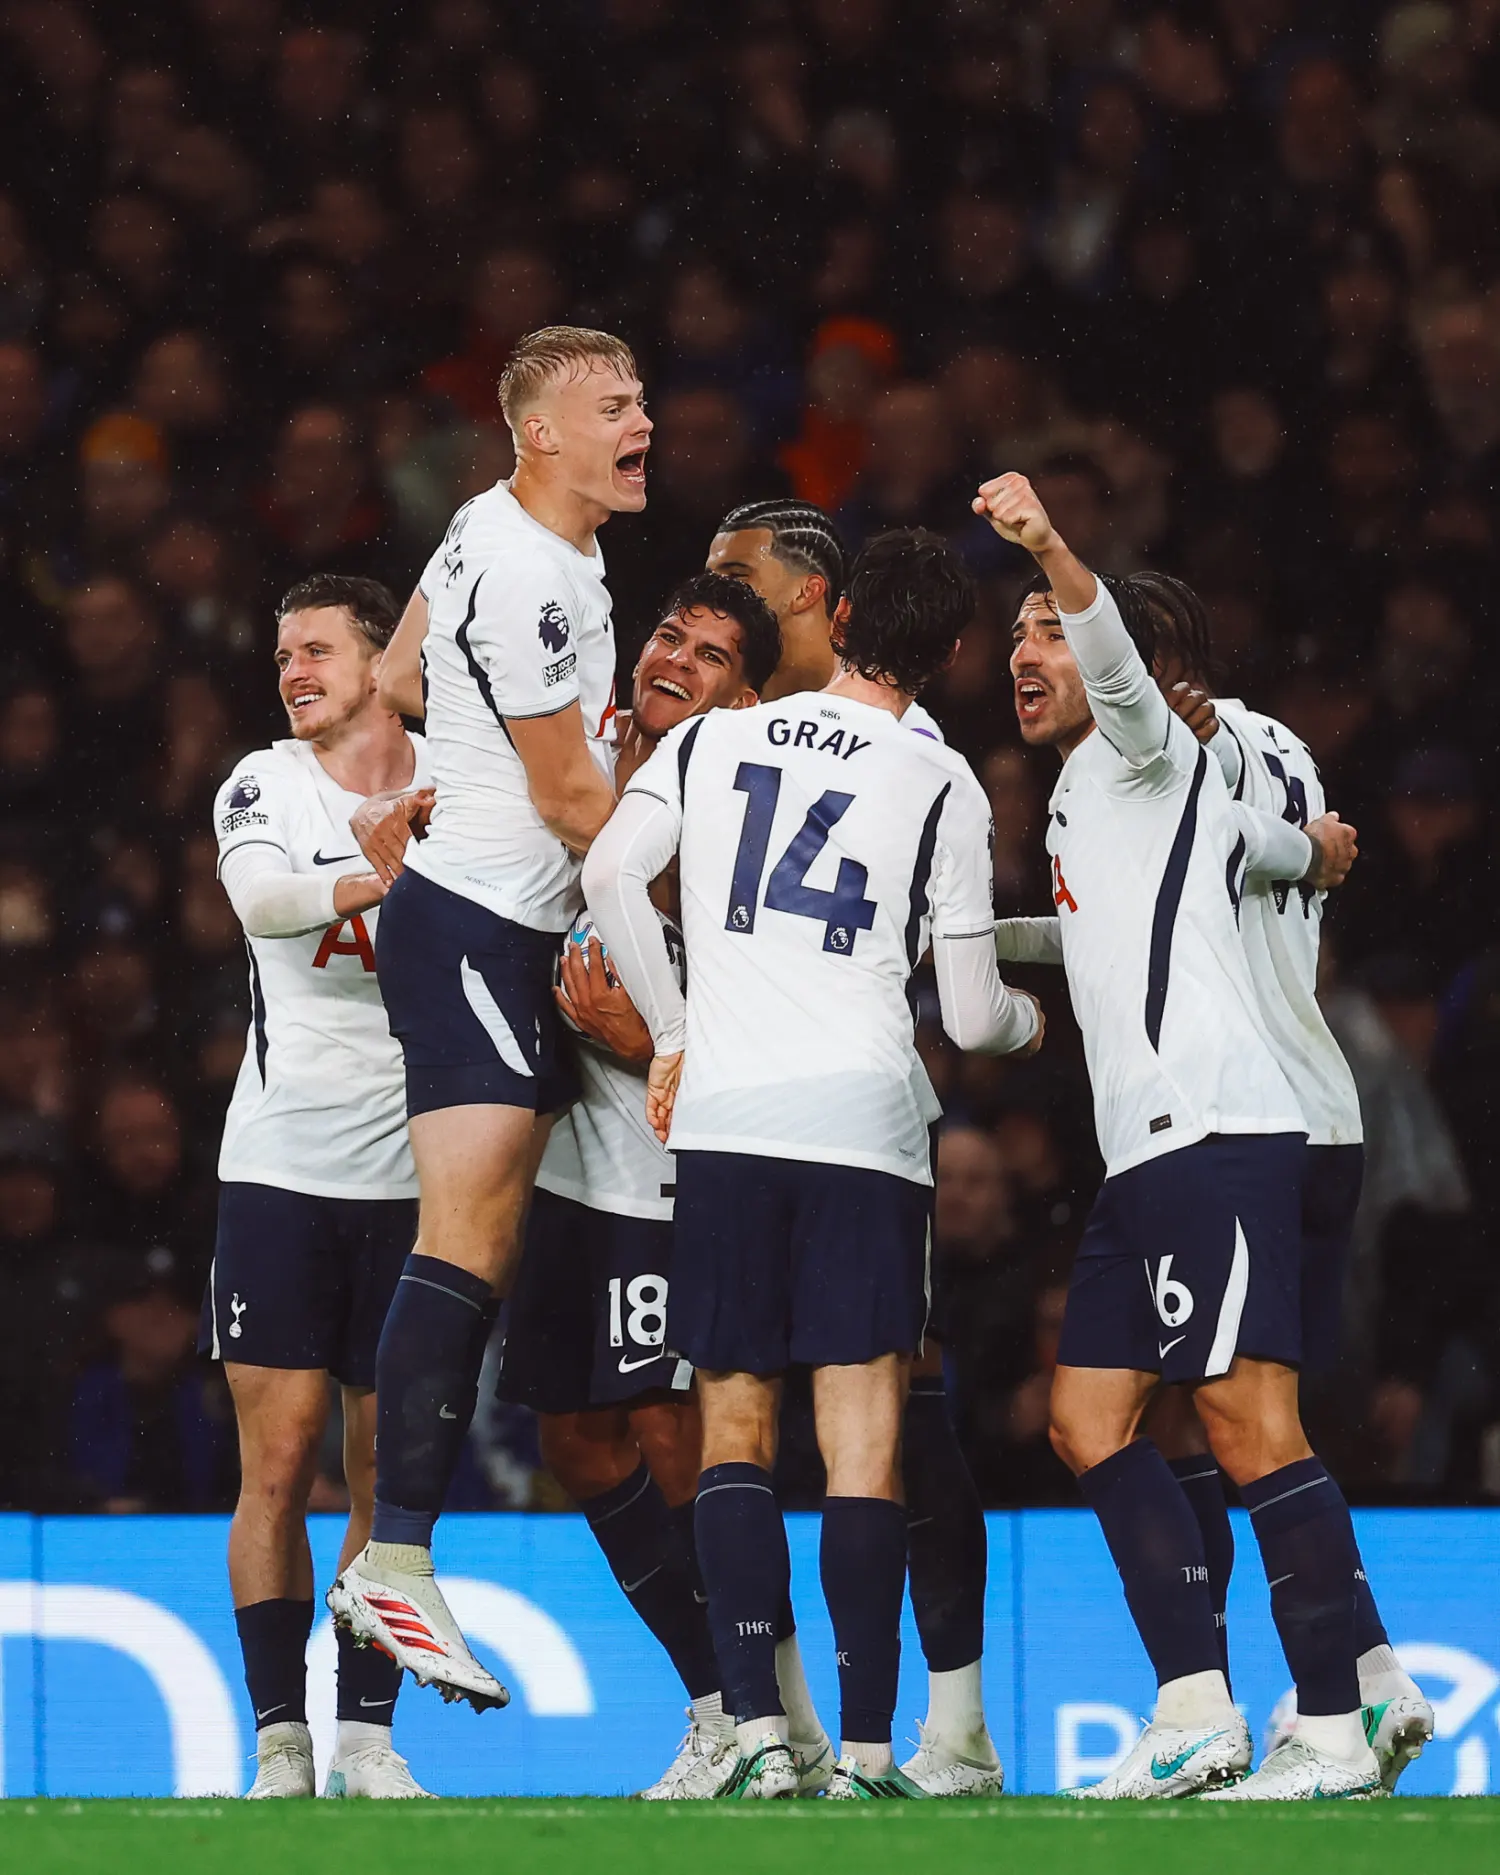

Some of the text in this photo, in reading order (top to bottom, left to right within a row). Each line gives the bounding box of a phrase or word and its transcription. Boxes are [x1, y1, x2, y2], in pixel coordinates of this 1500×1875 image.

[819, 709, 841, 721] 886
[767, 718, 872, 761] GRAY
[724, 761, 878, 957] 14
[608, 1273, 669, 1347] 18
[735, 1620, 773, 1637] THFC
